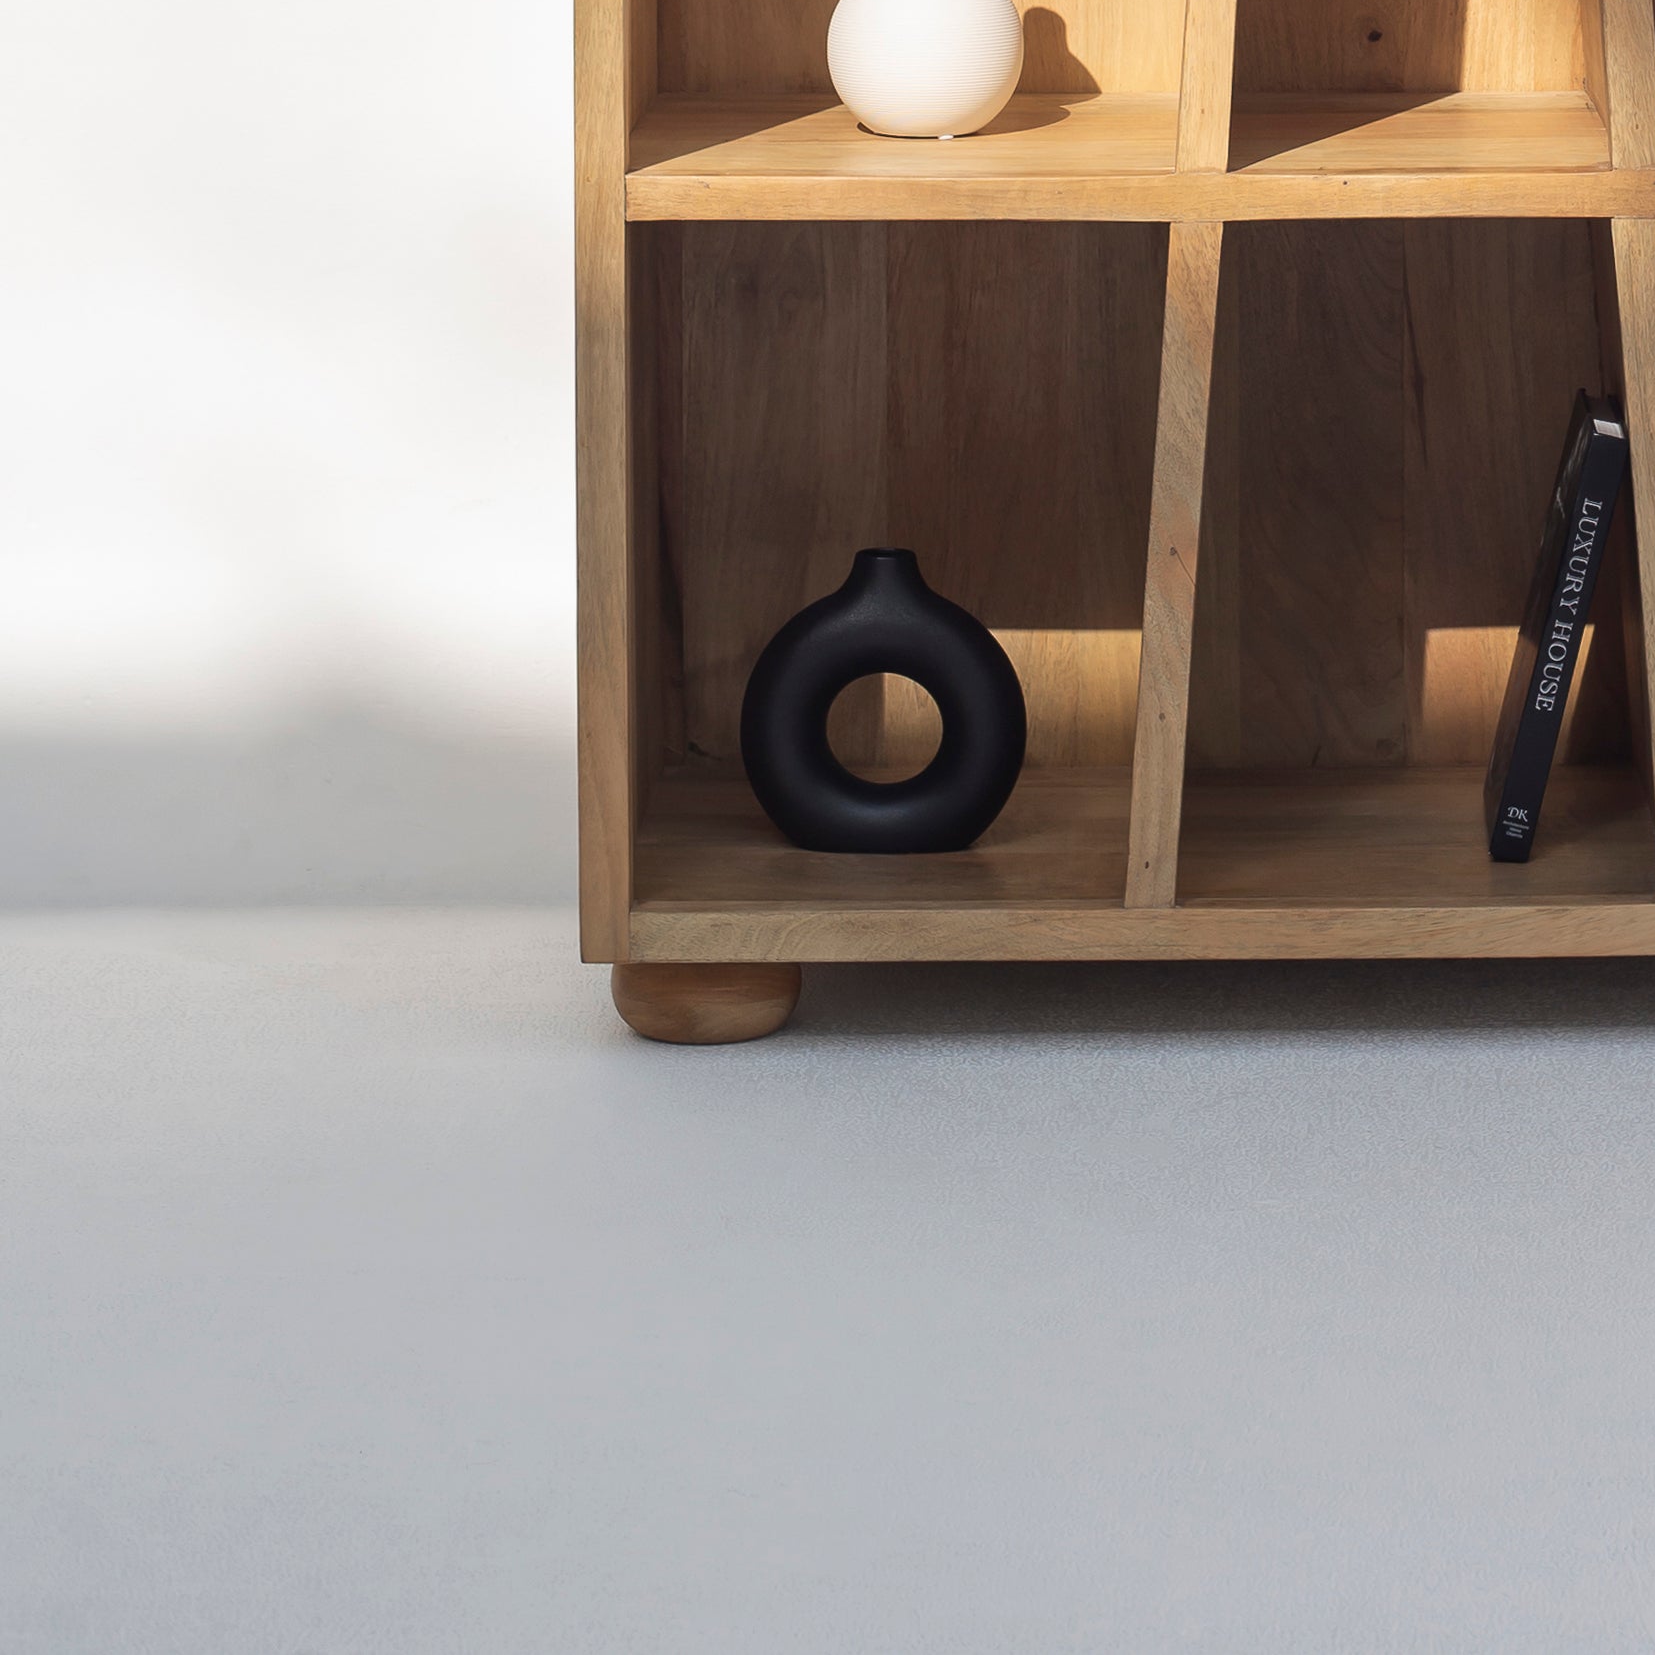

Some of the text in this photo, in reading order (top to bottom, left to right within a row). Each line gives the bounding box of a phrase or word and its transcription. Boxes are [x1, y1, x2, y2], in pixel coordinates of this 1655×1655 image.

[1535, 497, 1604, 713] LUXURY HOUSE
[1507, 806, 1529, 823] DK
